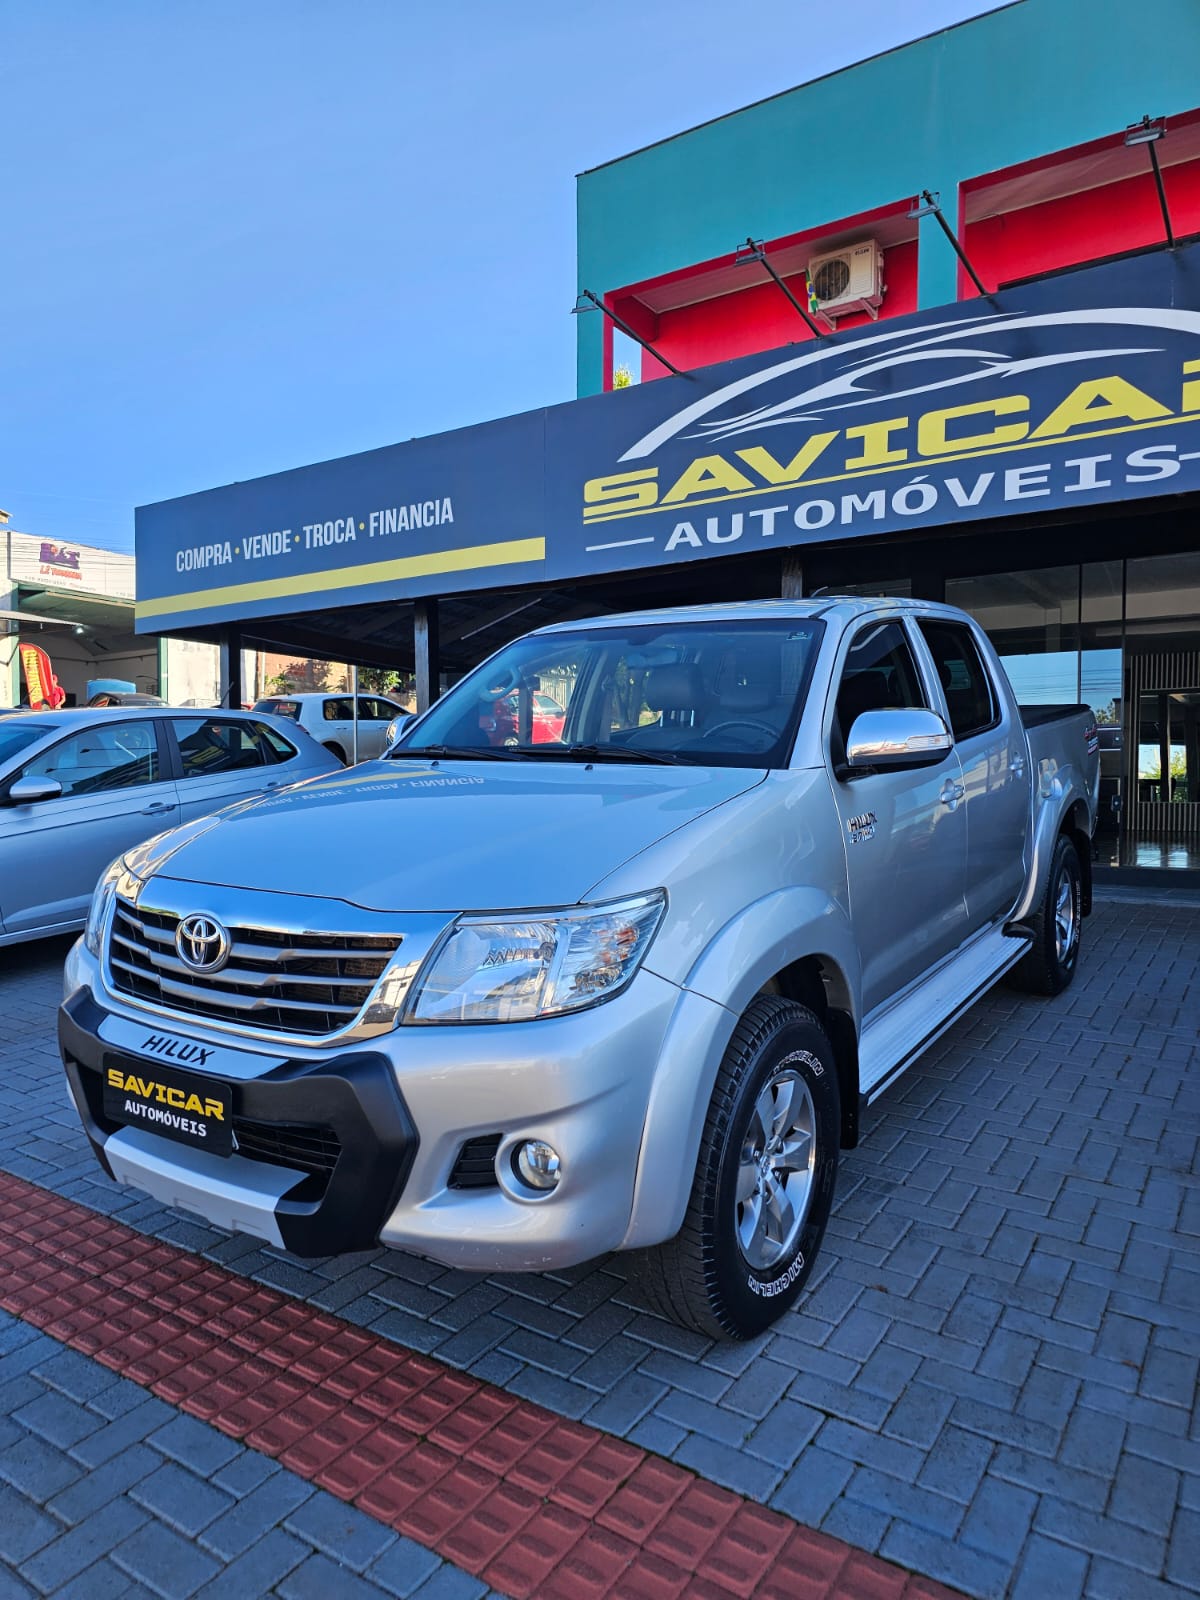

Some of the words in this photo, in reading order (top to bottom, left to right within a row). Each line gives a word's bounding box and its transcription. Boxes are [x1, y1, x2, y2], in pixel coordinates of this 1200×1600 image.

[664, 445, 1181, 551] AUTOMÓVEIS
[176, 541, 233, 573] COMPRA
[243, 529, 292, 561] VENDE
[302, 517, 357, 549] TROCA
[369, 497, 454, 538] FINANCIA
[141, 1035, 215, 1065] HILUX
[108, 1068, 225, 1121] SAVICAR
[124, 1099, 207, 1137] AUTOMÓVEIS
[747, 1251, 805, 1297] MICHELIN
